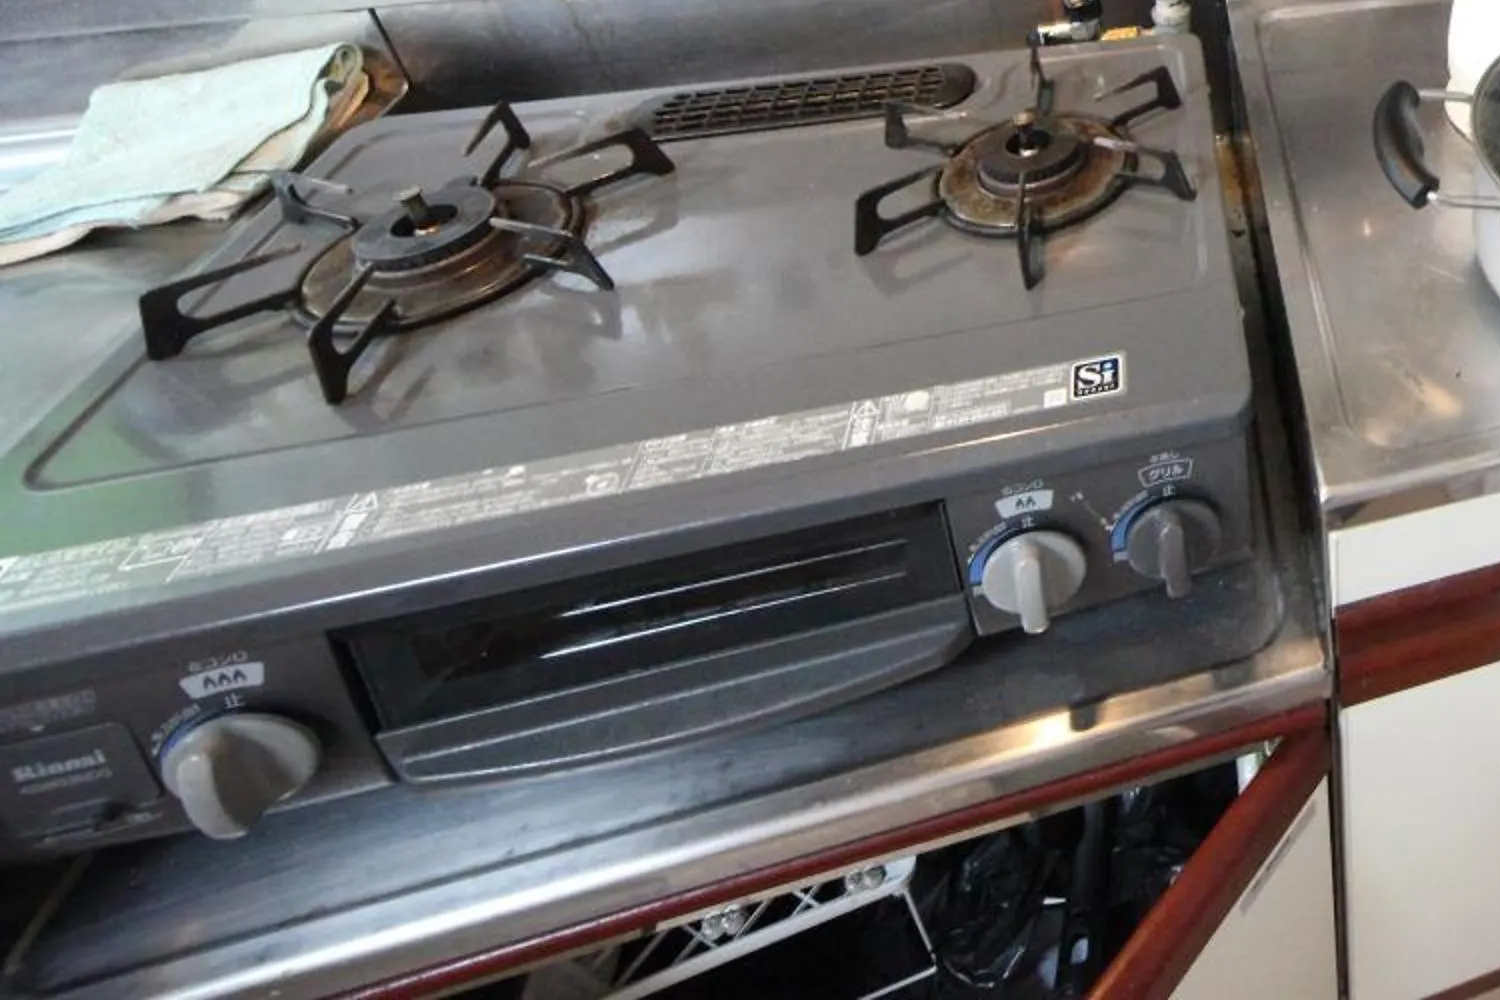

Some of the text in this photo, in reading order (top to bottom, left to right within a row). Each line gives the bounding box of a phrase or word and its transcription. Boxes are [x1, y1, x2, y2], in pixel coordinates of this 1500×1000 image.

[1077, 361, 1116, 389] Si
[1148, 466, 1185, 480] グリル
